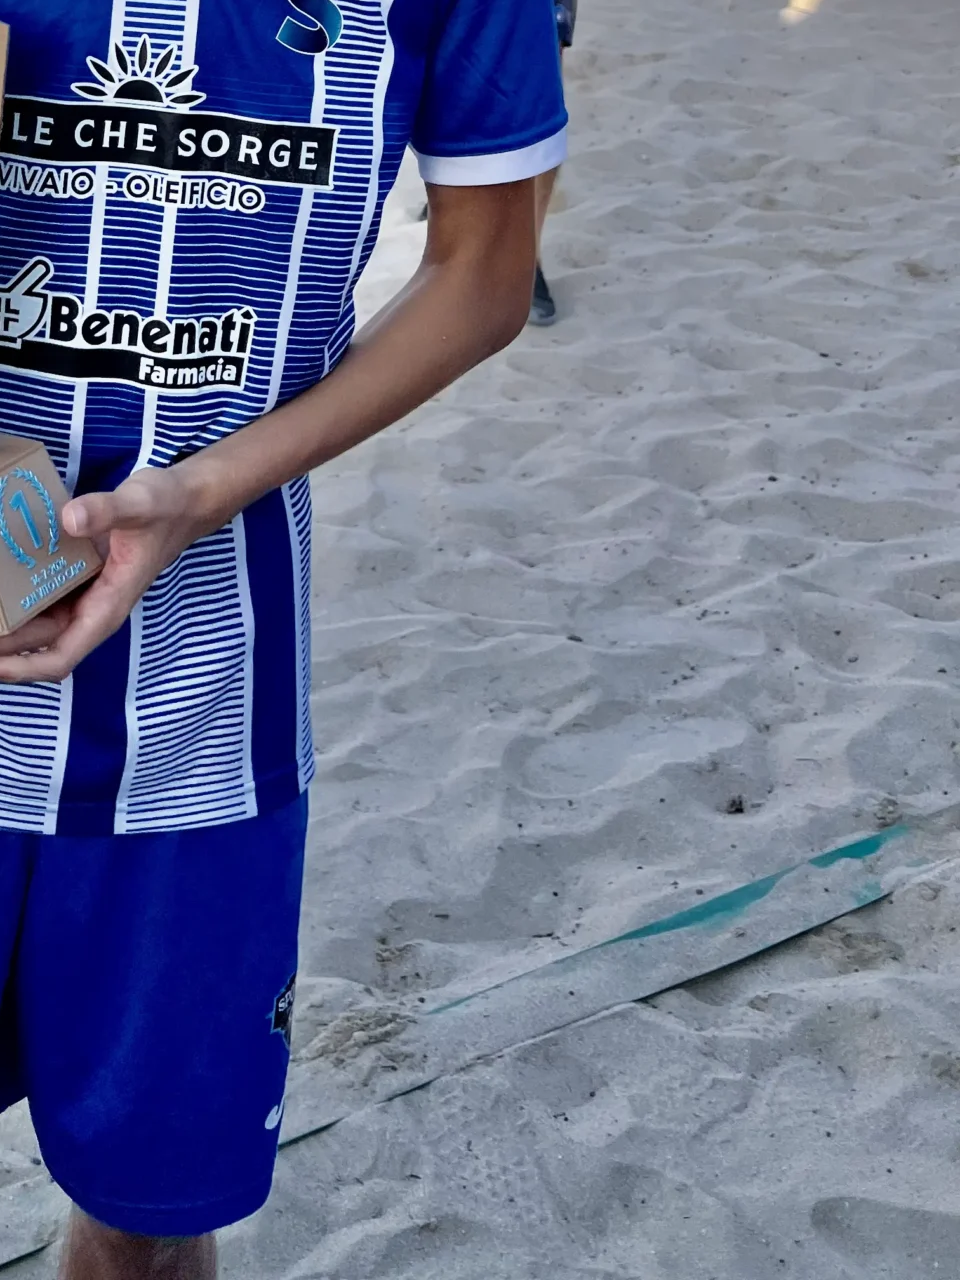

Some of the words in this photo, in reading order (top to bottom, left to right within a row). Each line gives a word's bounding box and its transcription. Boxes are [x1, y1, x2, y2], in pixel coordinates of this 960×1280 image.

[74, 119, 158, 153] CHE
[177, 128, 319, 170] SORGE
[125, 173, 263, 212] OLEIFICIO
[49, 295, 255, 356] Benenati
[139, 356, 238, 386] Farmacia
[9, 489, 44, 549] 1
